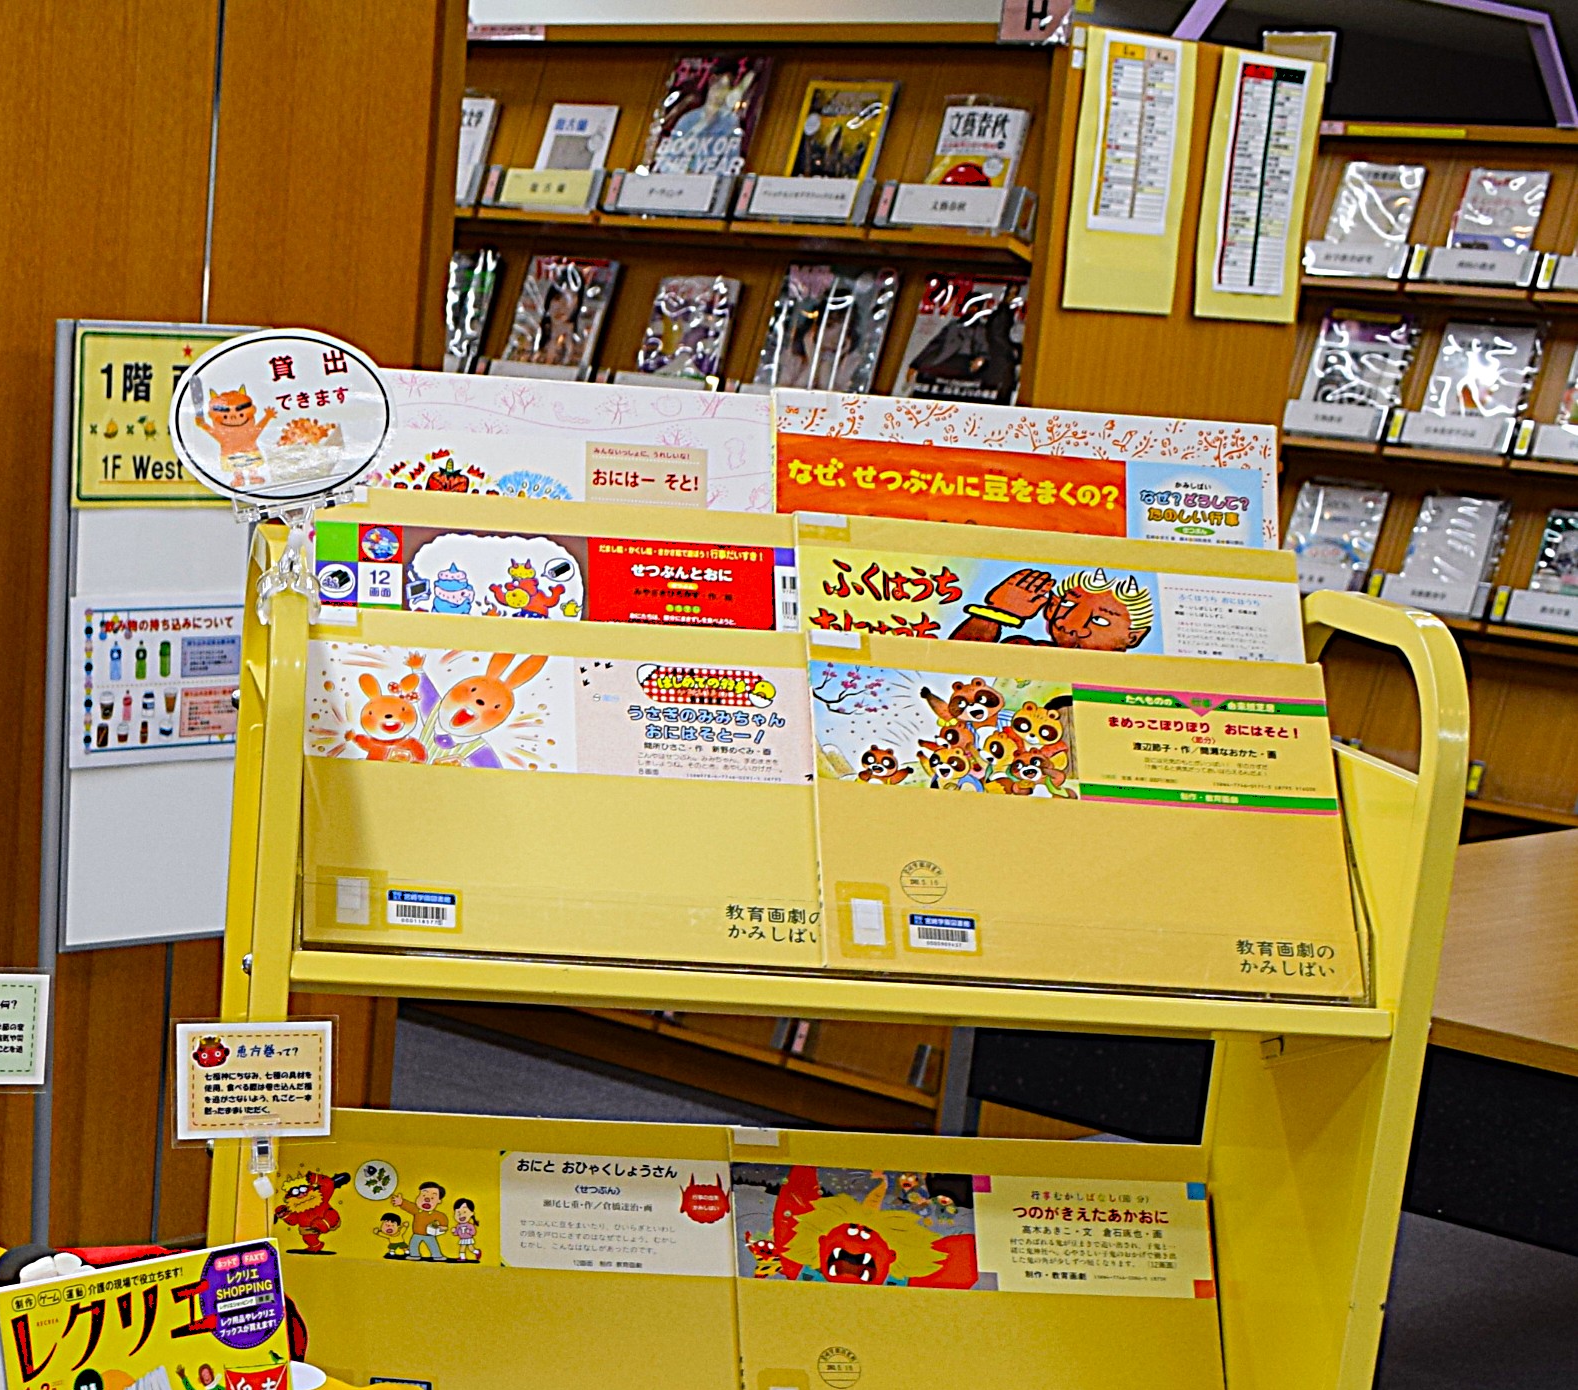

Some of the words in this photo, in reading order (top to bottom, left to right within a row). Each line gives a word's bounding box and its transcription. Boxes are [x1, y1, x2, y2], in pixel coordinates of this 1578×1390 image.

[276, 387, 349, 411] できます
[101, 454, 123, 479] 1F
[368, 570, 391, 585] 12
[631, 564, 733, 582] せつぶんとおに
[1236, 939, 1336, 961] 教育画劇の
[1239, 958, 1336, 977] かみしばい
[517, 1158, 555, 1173] おにと
